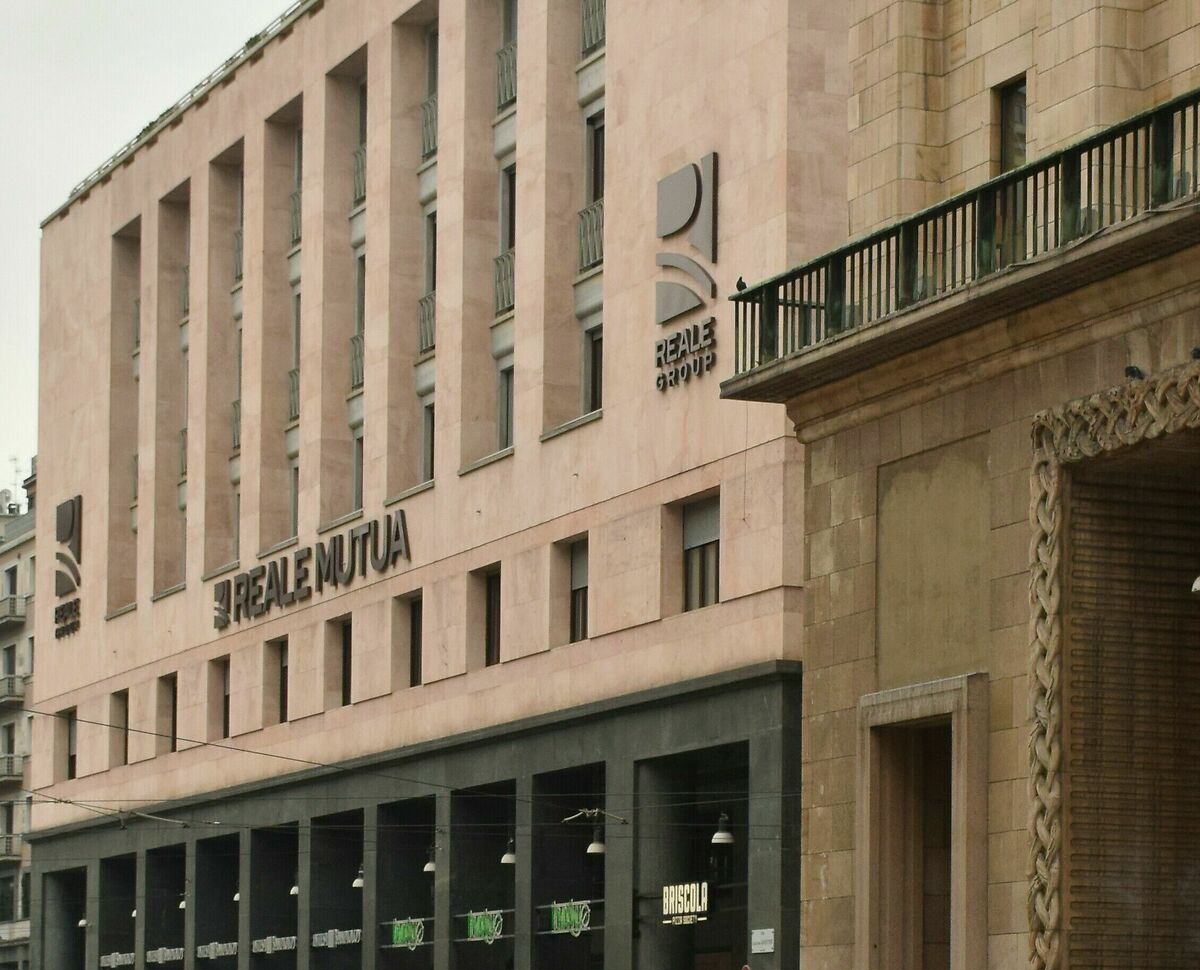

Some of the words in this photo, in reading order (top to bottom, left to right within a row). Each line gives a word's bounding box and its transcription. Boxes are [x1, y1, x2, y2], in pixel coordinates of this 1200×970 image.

[655, 316, 717, 369] REALE
[656, 351, 717, 392] GROUP
[233, 547, 312, 624] REALE
[315, 509, 411, 595] MUTUA
[662, 881, 708, 915] BRISCOLA
